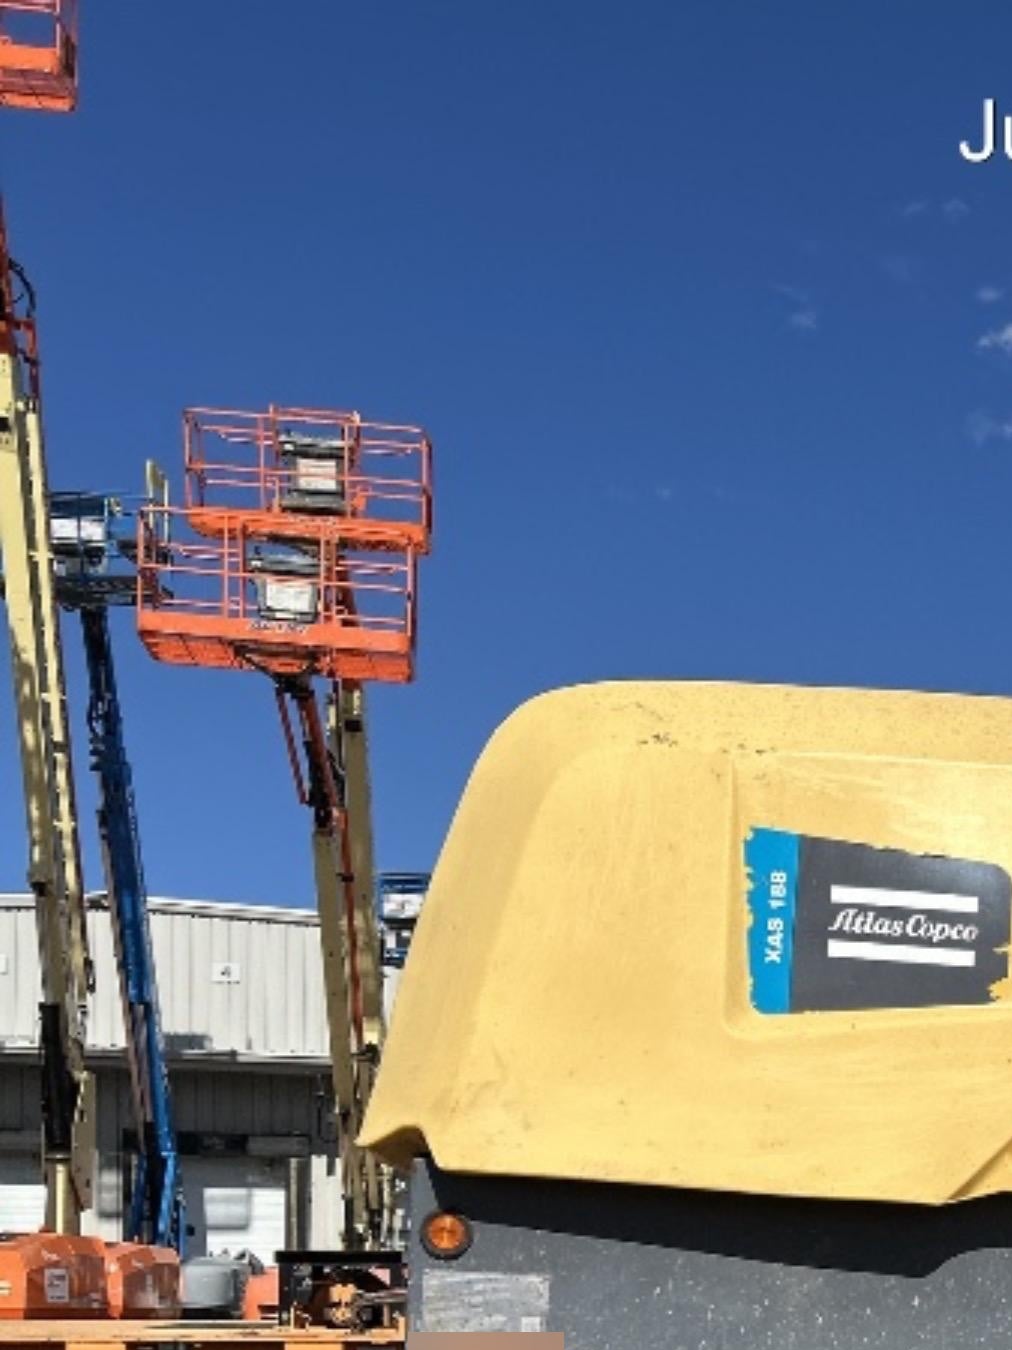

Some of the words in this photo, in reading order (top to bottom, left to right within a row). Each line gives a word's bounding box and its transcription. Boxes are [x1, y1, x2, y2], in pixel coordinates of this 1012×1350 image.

[768, 872, 787, 910] 188
[764, 918, 784, 964] XAS
[828, 908, 904, 937] Atlas
[905, 914, 979, 944] Copco
